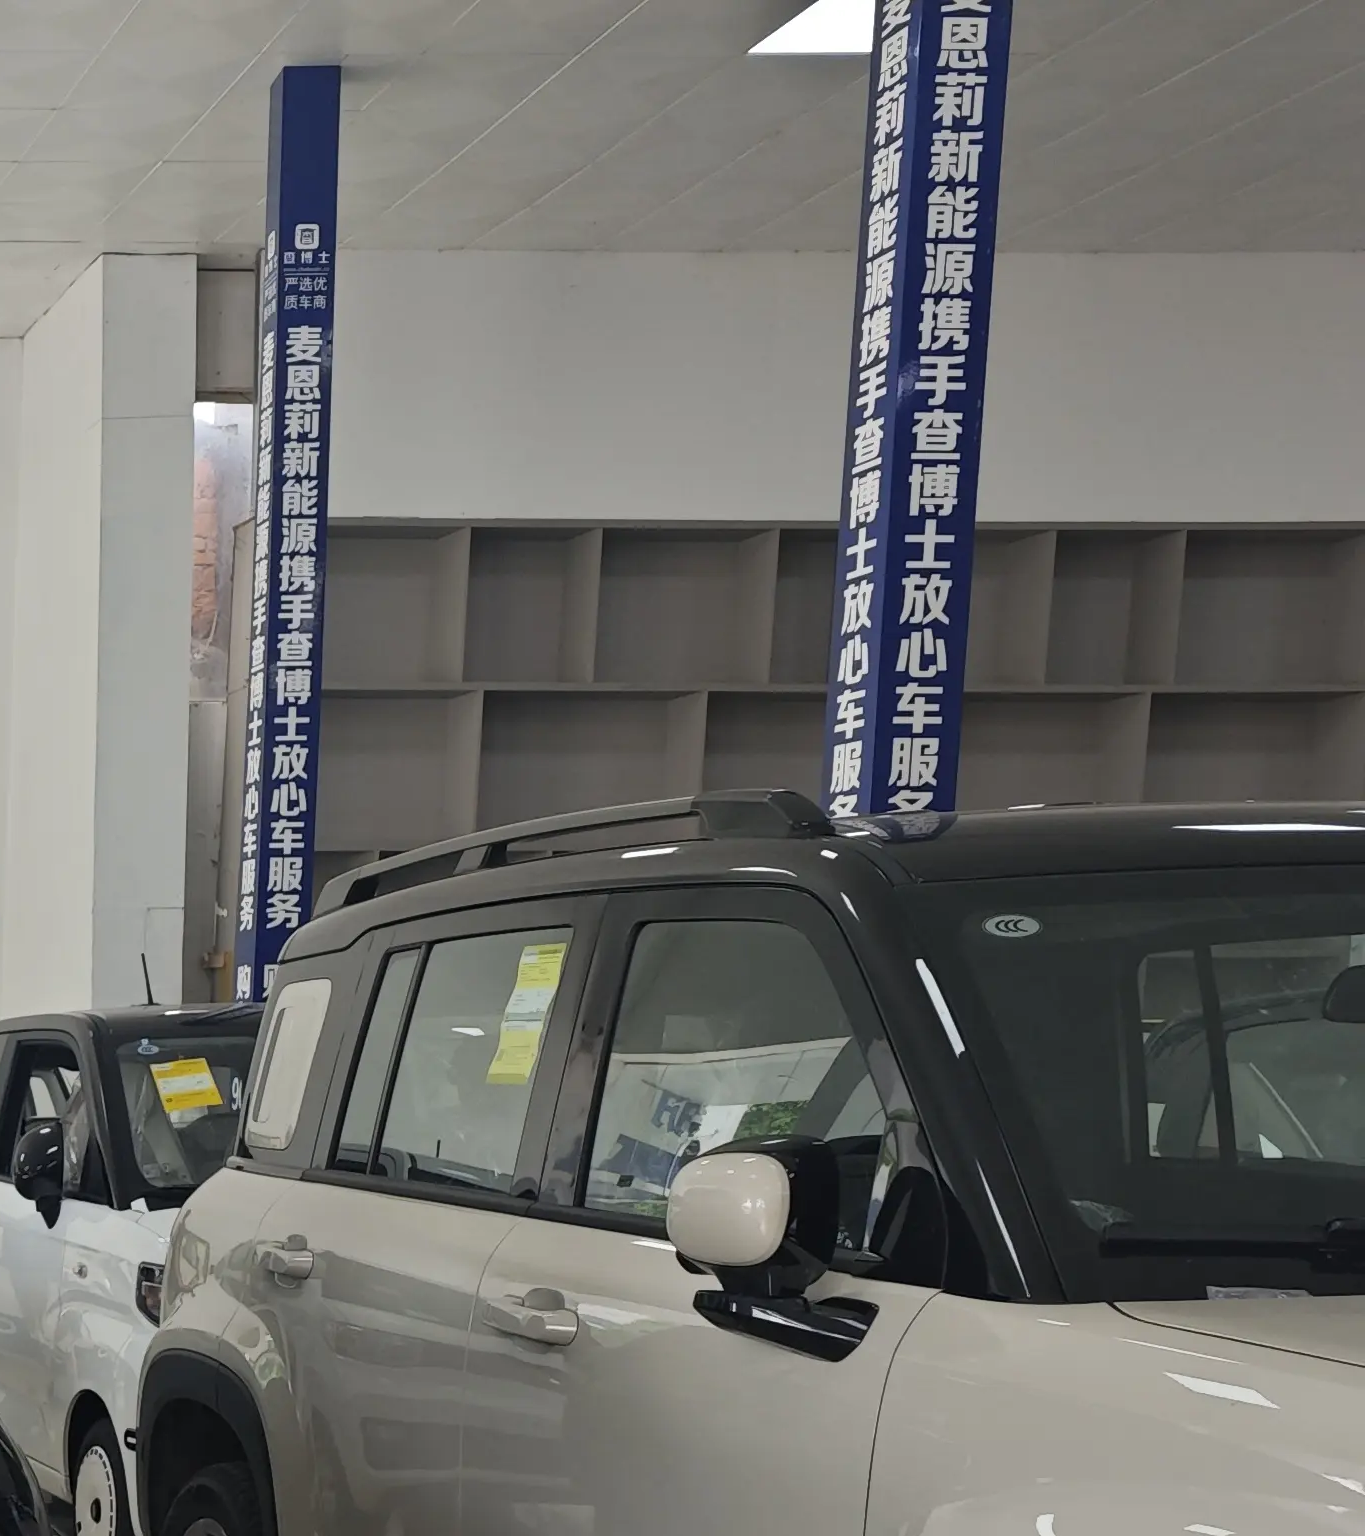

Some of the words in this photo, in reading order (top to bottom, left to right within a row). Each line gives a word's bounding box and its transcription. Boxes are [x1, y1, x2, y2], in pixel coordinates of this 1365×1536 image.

[284, 276, 328, 291] 严选优
[284, 294, 328, 310] 质车商
[887, 0, 991, 812] 恩莉新能源携手查博士放心车服
[266, 325, 323, 929] 麦恩莉新能源携手查博士放心车服务
[236, 964, 252, 1004] 购
